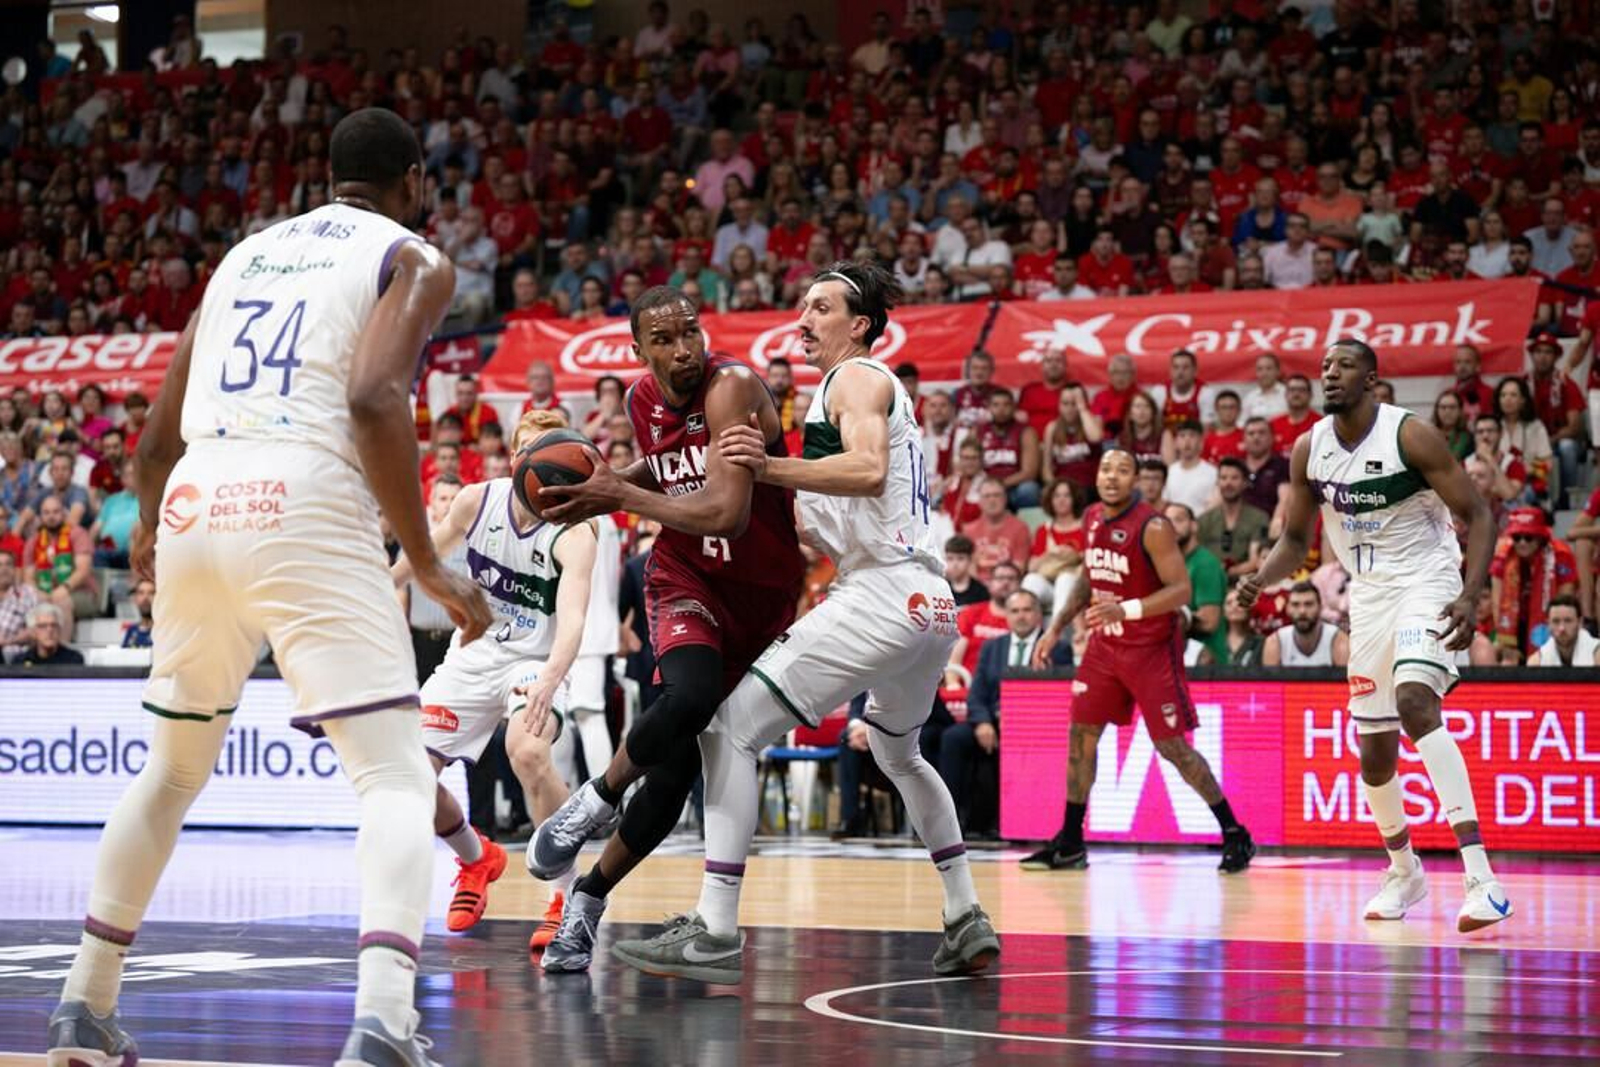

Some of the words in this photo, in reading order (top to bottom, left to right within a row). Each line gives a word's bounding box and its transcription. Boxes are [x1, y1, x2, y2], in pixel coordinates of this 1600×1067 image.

[219, 299, 307, 397] 34
[1124, 301, 1493, 356] CaixaBank
[0, 332, 179, 374] caser
[215, 480, 288, 499] COSTA
[907, 442, 930, 525] 14
[1338, 490, 1387, 507] Unicaja
[210, 504, 242, 518] DEL
[246, 499, 285, 516] SOL
[1349, 543, 1375, 575] 17
[1494, 773, 1600, 827] DEL
